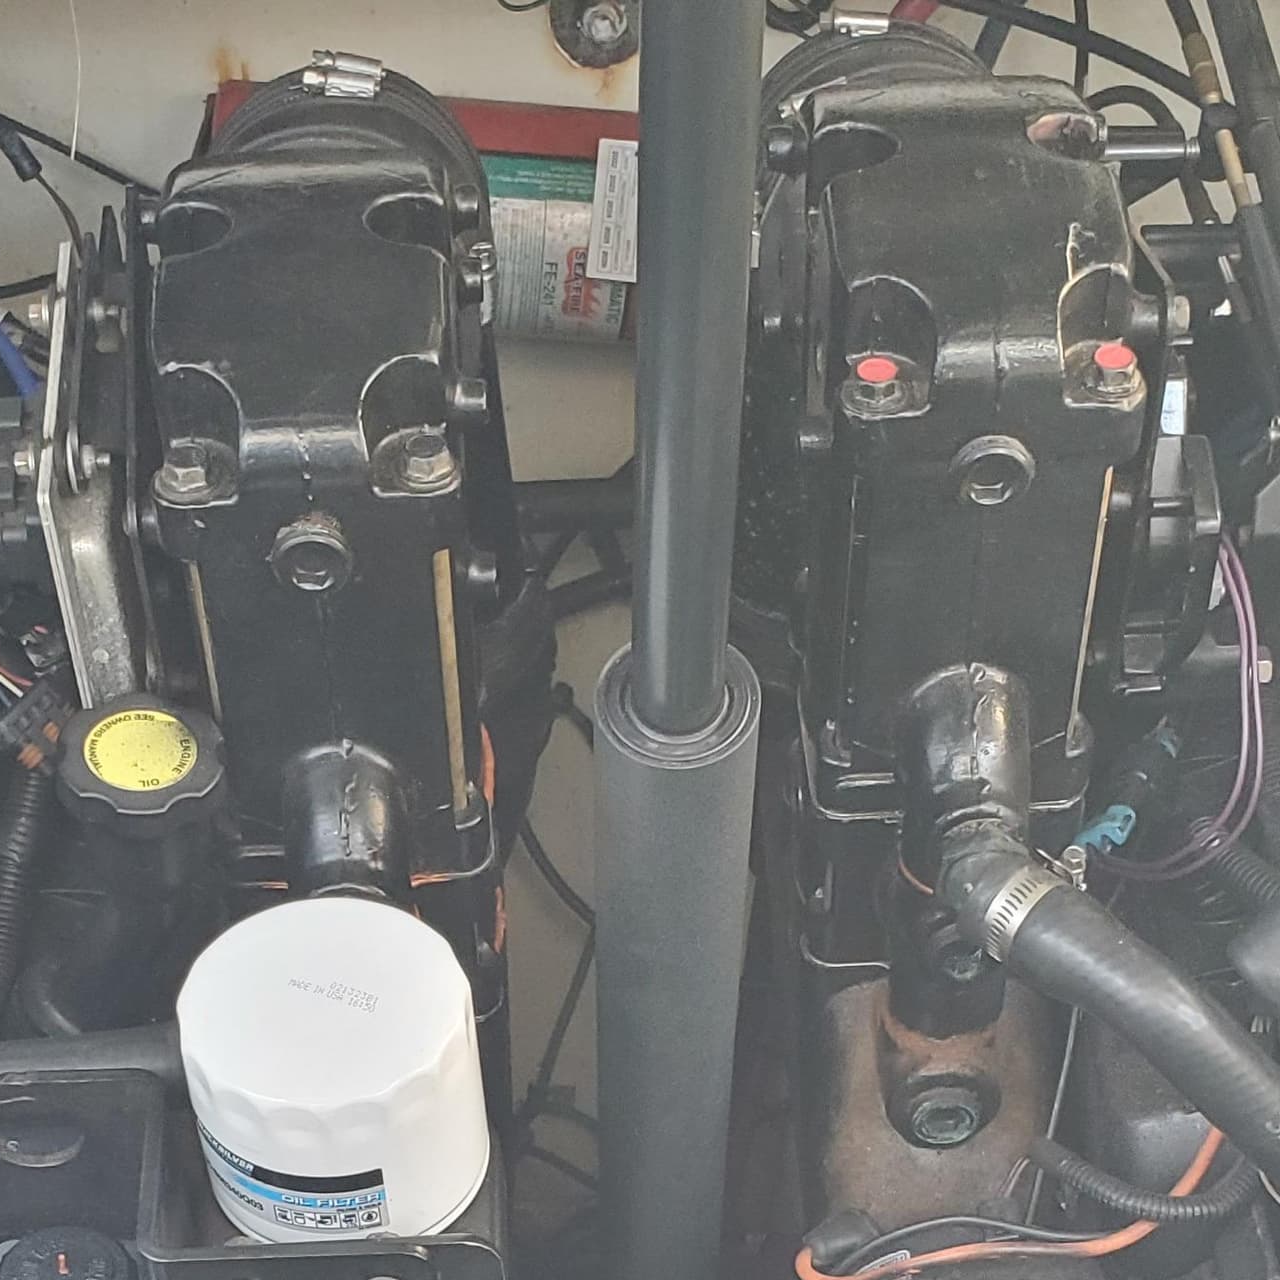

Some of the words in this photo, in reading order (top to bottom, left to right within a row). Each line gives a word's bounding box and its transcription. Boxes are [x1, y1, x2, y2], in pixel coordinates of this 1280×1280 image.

[93, 714, 132, 738] OWNERS
[88, 738, 103, 774] MANUAL
[172, 738, 192, 775] ENGINE
[138, 778, 160, 788] OIL
[313, 984, 326, 995] IN
[326, 989, 344, 1001] USA
[281, 1193, 313, 1206] OIL
[317, 1192, 382, 1208] FILTER
